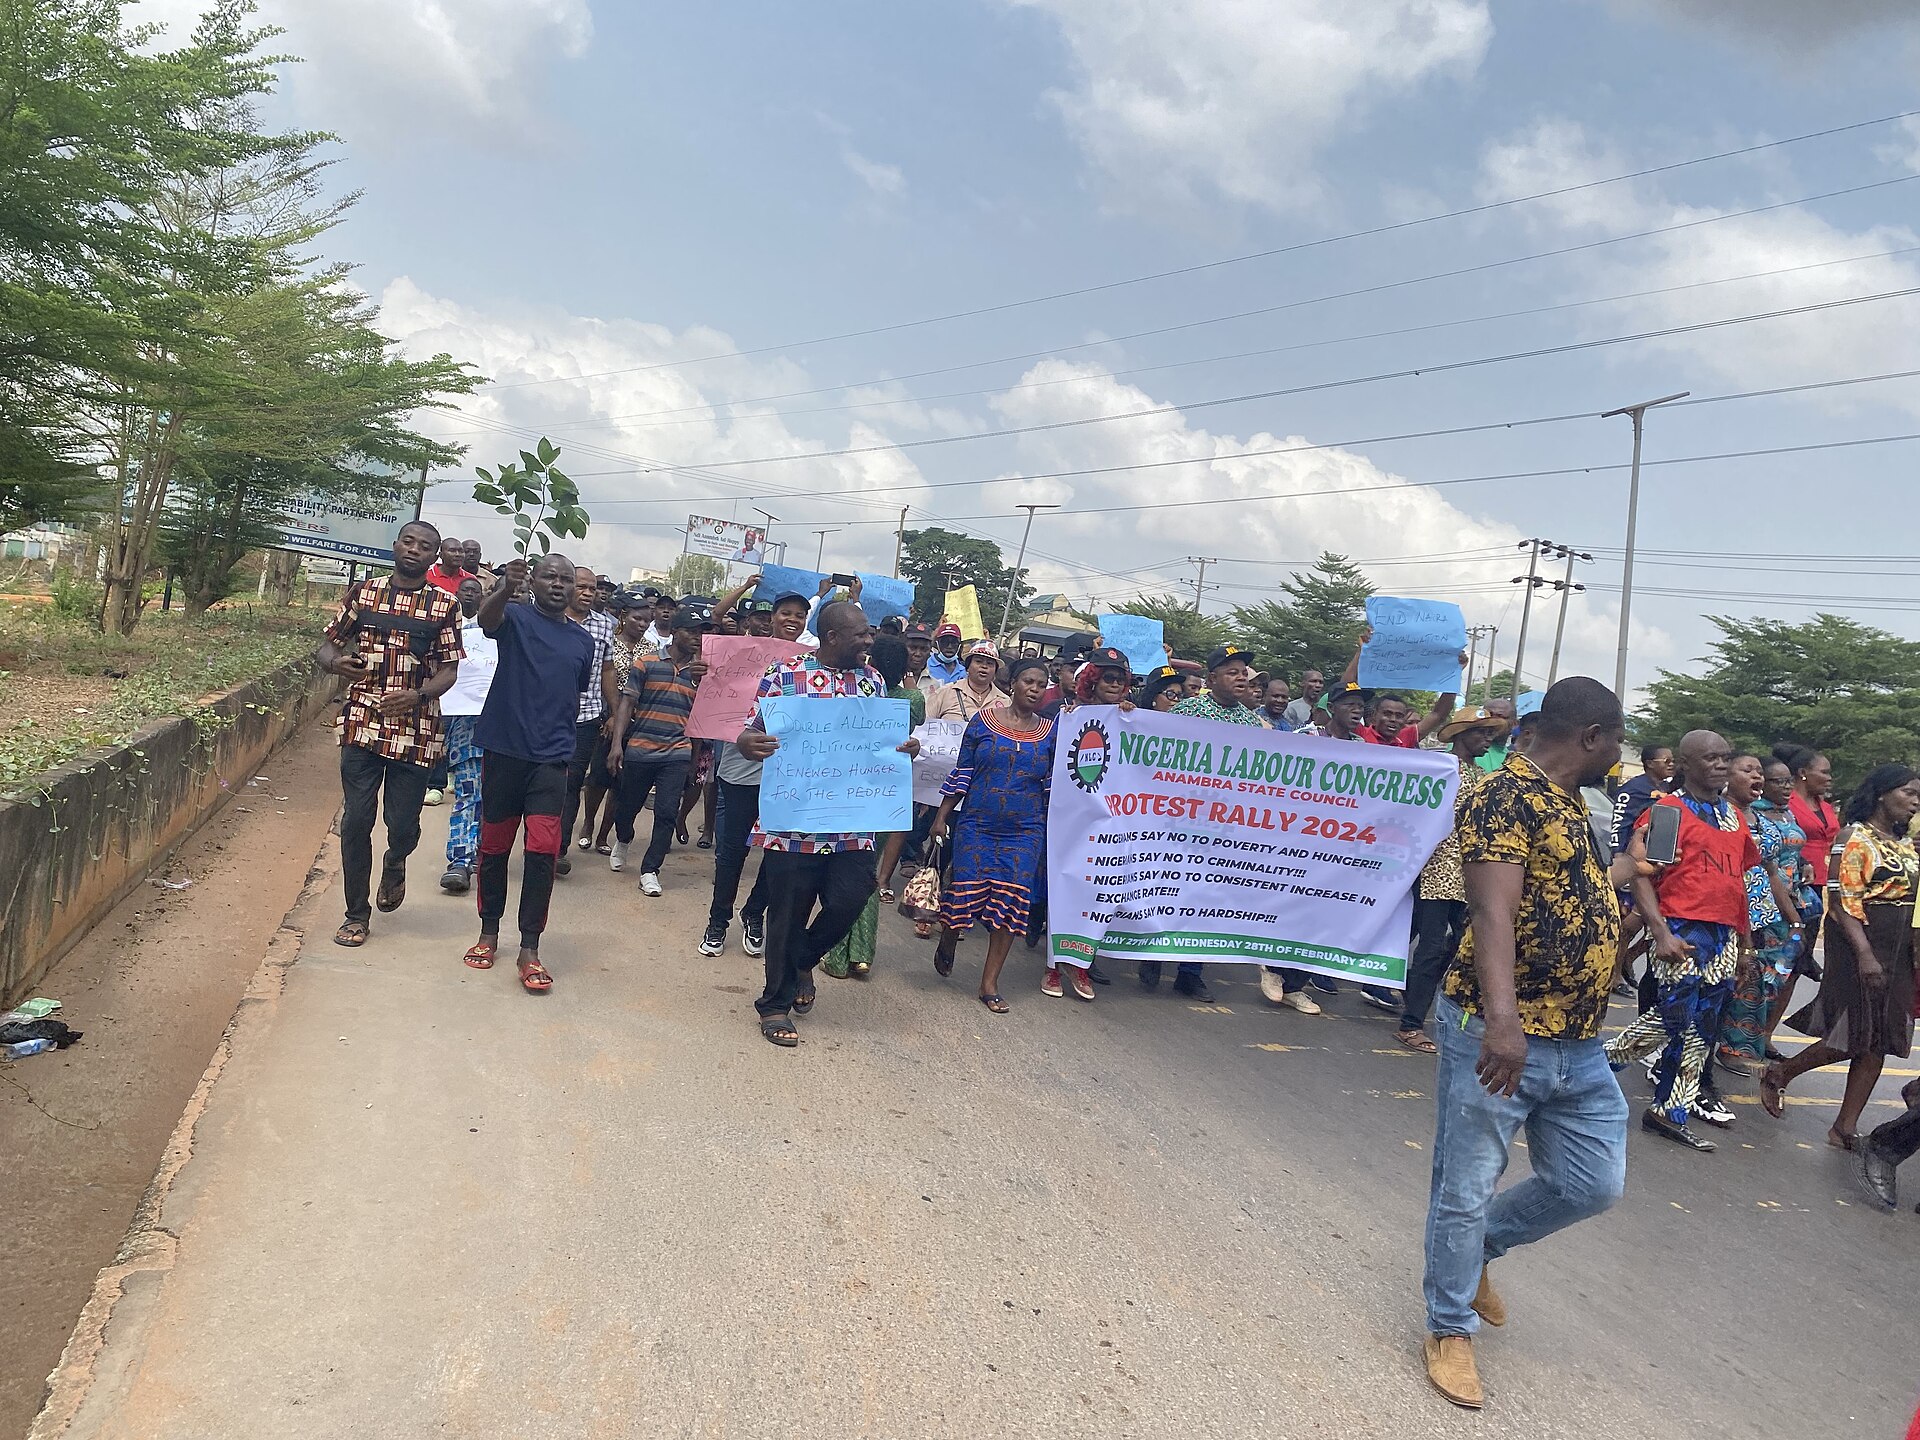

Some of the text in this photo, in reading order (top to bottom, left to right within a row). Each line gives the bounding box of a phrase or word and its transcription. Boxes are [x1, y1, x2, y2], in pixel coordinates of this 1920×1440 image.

[331, 505, 398, 523] PARTNERSHIP
[291, 536, 337, 549] WELFARE
[339, 543, 359, 553] FOR
[360, 548, 380, 557] ALL
[1375, 604, 1407, 626] END
[704, 685, 738, 699] END
[772, 711, 908, 734] DOUBLE ALLOCATION
[928, 721, 963, 736] END
[802, 740, 881, 755] POLITICIANS
[776, 755, 900, 777] RENEWED HUNGER
[1118, 731, 1447, 810] NIGERIA LABOUR CONGRESS
[771, 784, 899, 801] FOR THE PEOPLE
[1152, 771, 1359, 809] ANAMBRA STATE COUNCIL
[1104, 793, 1377, 845] PROTEST RALLY 2024
[1140, 831, 1165, 841] SAY
[1167, 832, 1187, 842] NO
[1191, 834, 1209, 844] TO
[1212, 837, 1277, 854] POVERTY
[1278, 847, 1309, 858] AND
[1312, 852, 1383, 870] HUNGER!!!
[1139, 852, 1162, 863] SAY
[1163, 853, 1183, 863] NO
[1187, 854, 1204, 864] TO
[1207, 856, 1308, 878] CRIMINALITY!!!
[1096, 887, 1181, 903] EXCHANGE RATE!!!
[1139, 870, 1160, 881] SAY
[1161, 870, 1181, 881] NO
[1185, 872, 1202, 882] TO
[1204, 873, 1288, 893] CONSISTENT
[1289, 885, 1359, 903] INCREASE
[1360, 895, 1377, 907] IN
[1144, 907, 1156, 919] SAY
[1157, 906, 1175, 916] NO
[1179, 907, 1196, 917] TO
[1198, 908, 1278, 924] HARDSHIP!!!
[1059, 939, 1095, 955] DATE:
[1149, 937, 1170, 946] AND
[1173, 937, 1243, 949] WEDNESDAY
[1244, 941, 1274, 952] 28TH
[1276, 945, 1293, 955] OF
[1294, 947, 1357, 966] FEBRUARY
[1358, 958, 1388, 972] 2024
